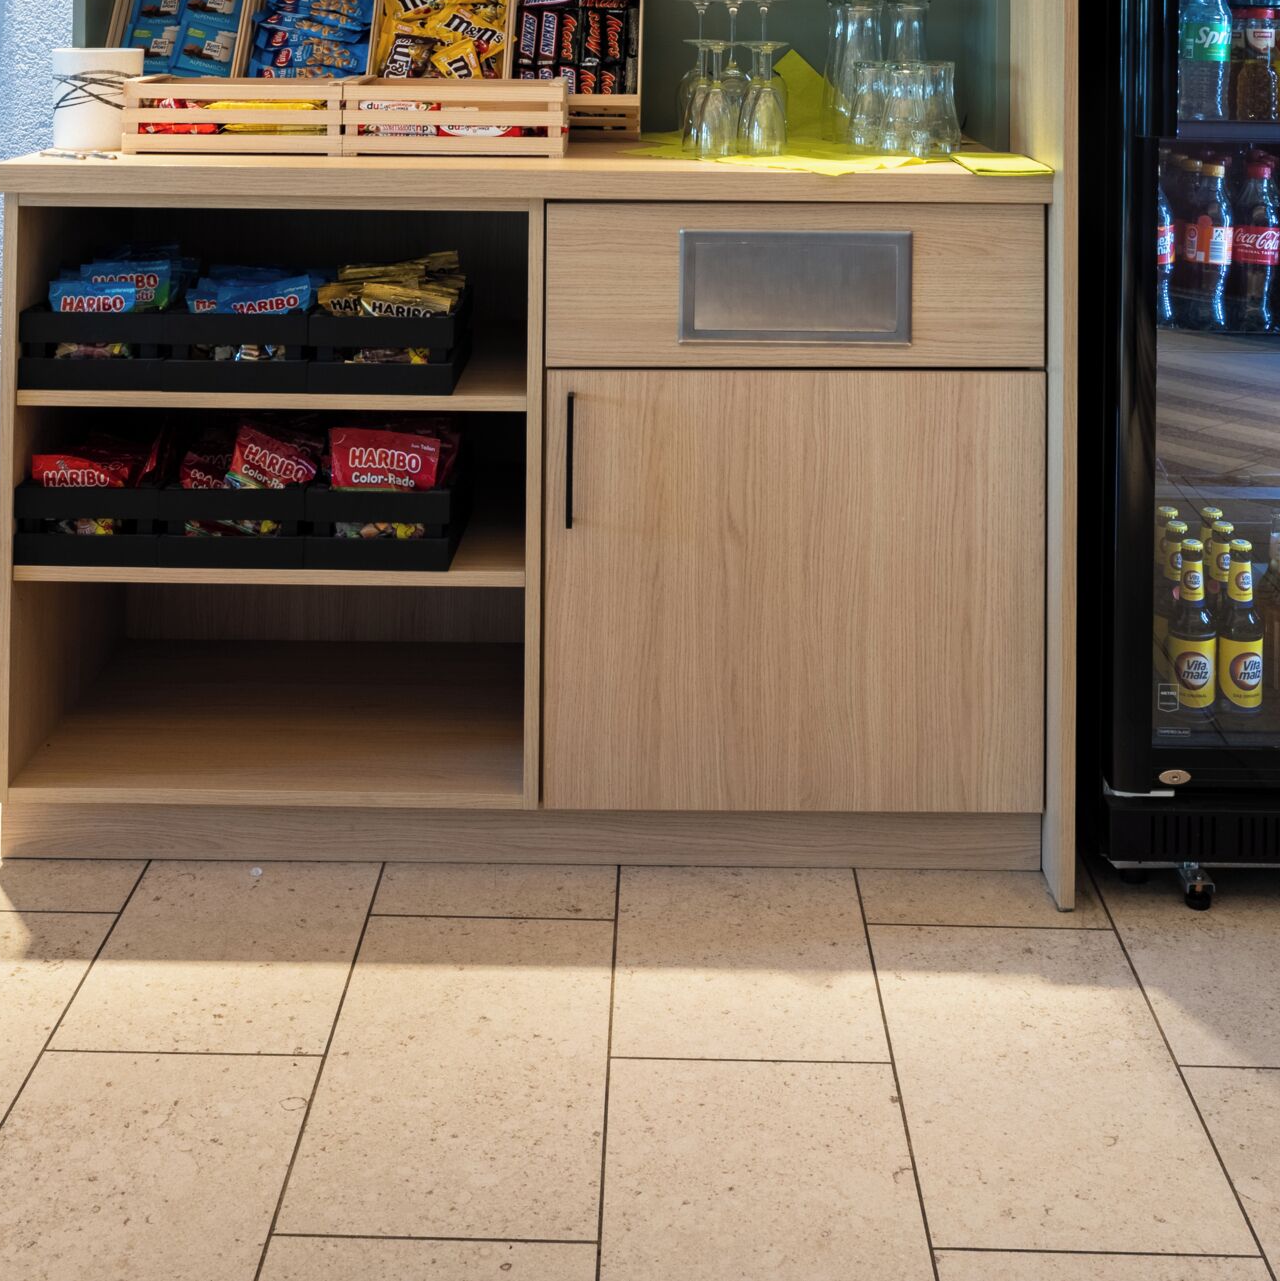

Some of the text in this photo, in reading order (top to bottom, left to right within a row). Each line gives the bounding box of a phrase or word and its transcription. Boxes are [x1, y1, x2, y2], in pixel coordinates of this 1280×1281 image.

[522, 14, 536, 56] SNICKERS
[541, 13, 556, 55] SNICKERS
[561, 14, 578, 60] Mars
[585, 10, 600, 56] Mars
[606, 14, 623, 59] Mars
[61, 295, 125, 312] HARIBO
[232, 294, 299, 314] HARIBO
[371, 301, 433, 317] HARIBO
[243, 444, 307, 482] HARIBO
[349, 447, 422, 474] HARIBO
[43, 469, 109, 487] HARIBO
[352, 472, 415, 488] Color-Rado
[1187, 660, 1207, 670] Vita
[1243, 660, 1261, 671] Vita
[1182, 670, 1209, 680] malz
[1239, 670, 1261, 680] malz
